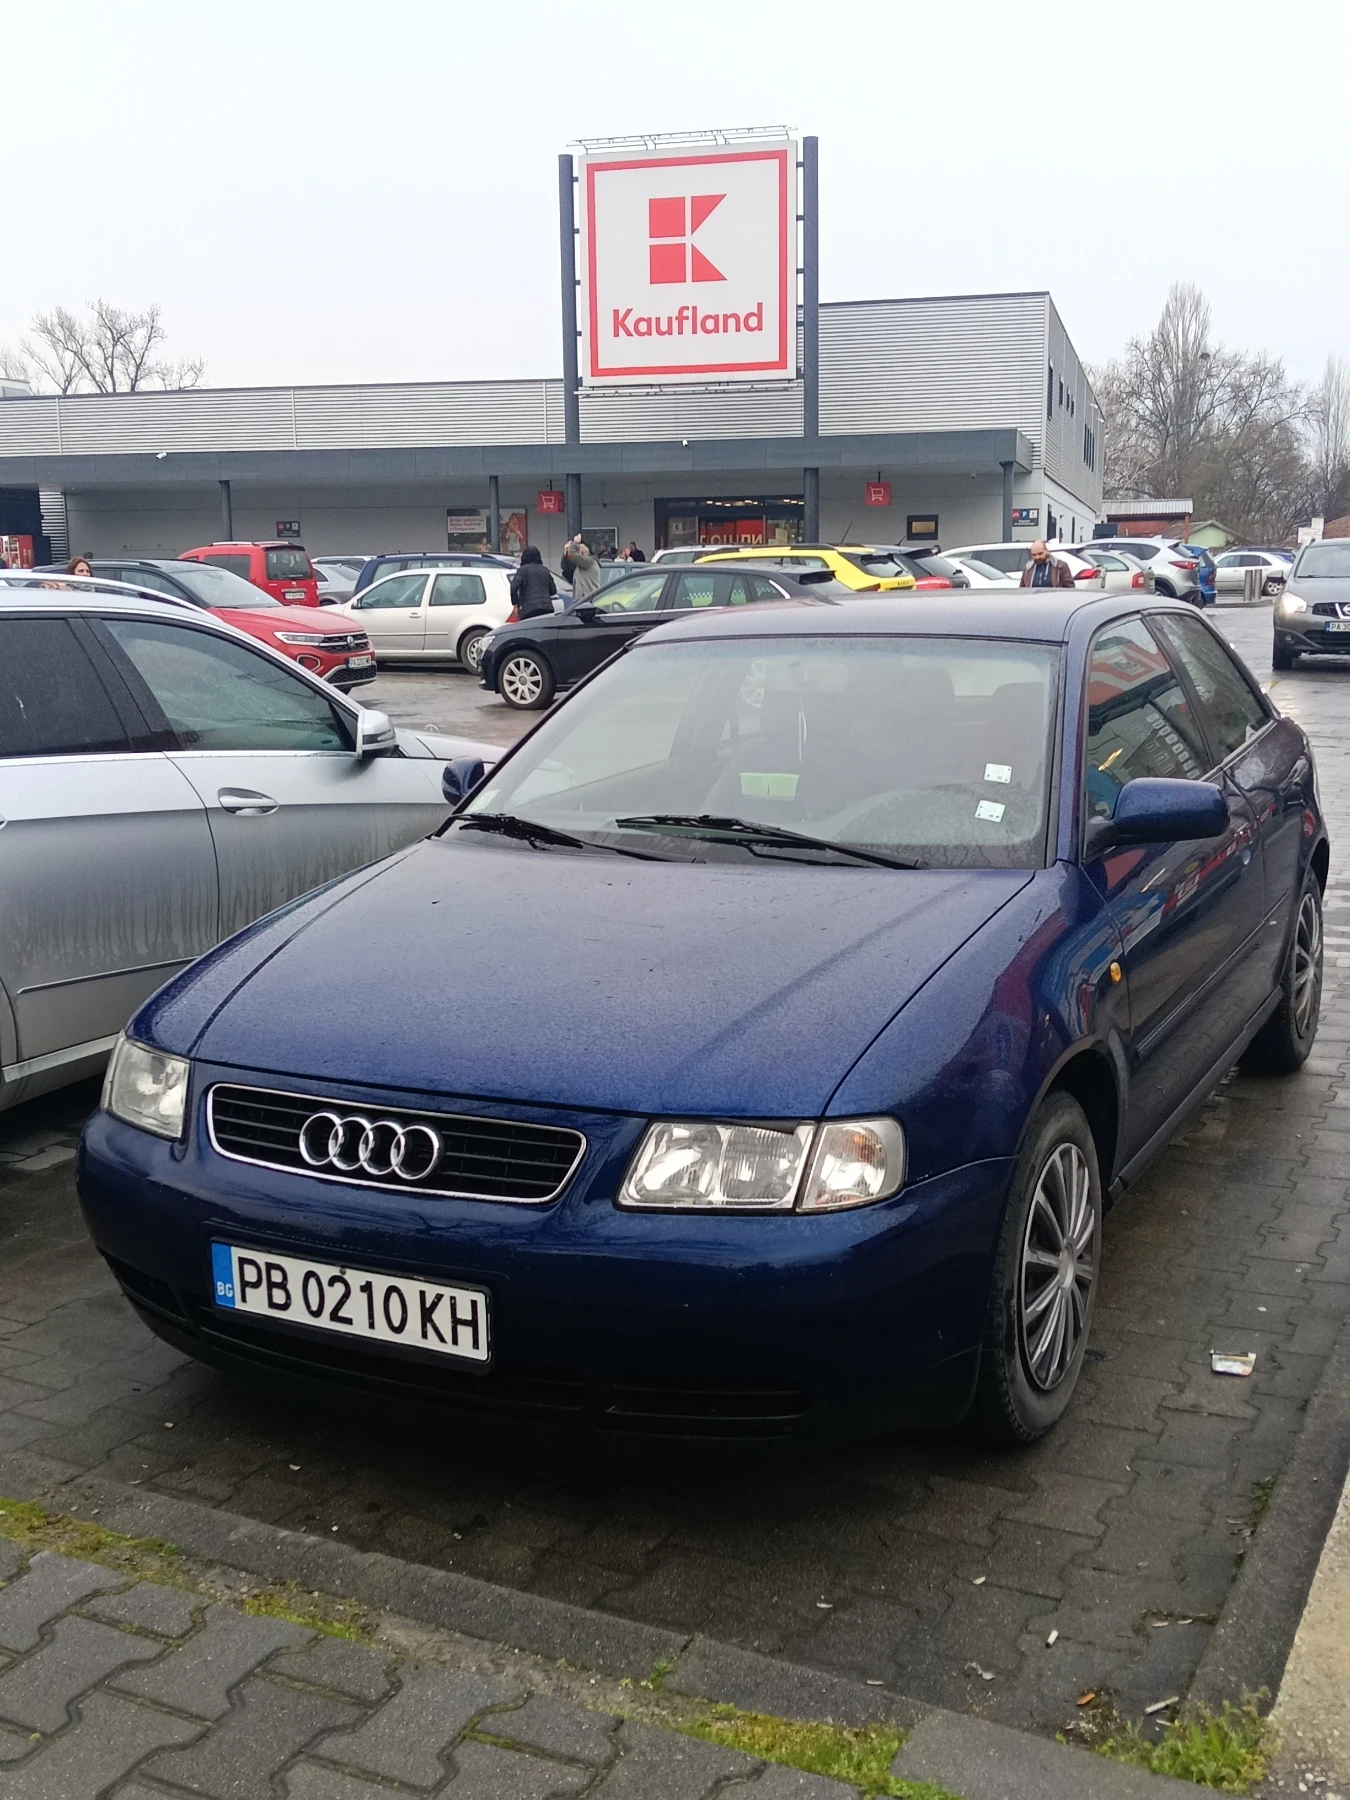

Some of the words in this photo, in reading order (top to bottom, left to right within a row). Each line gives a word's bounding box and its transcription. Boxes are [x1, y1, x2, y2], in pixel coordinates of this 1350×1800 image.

[612, 302, 763, 338] Kaufland
[216, 1281, 233, 1297] BG
[237, 1256, 292, 1312] PB
[302, 1270, 408, 1334] 0210
[419, 1289, 481, 1350] KH
